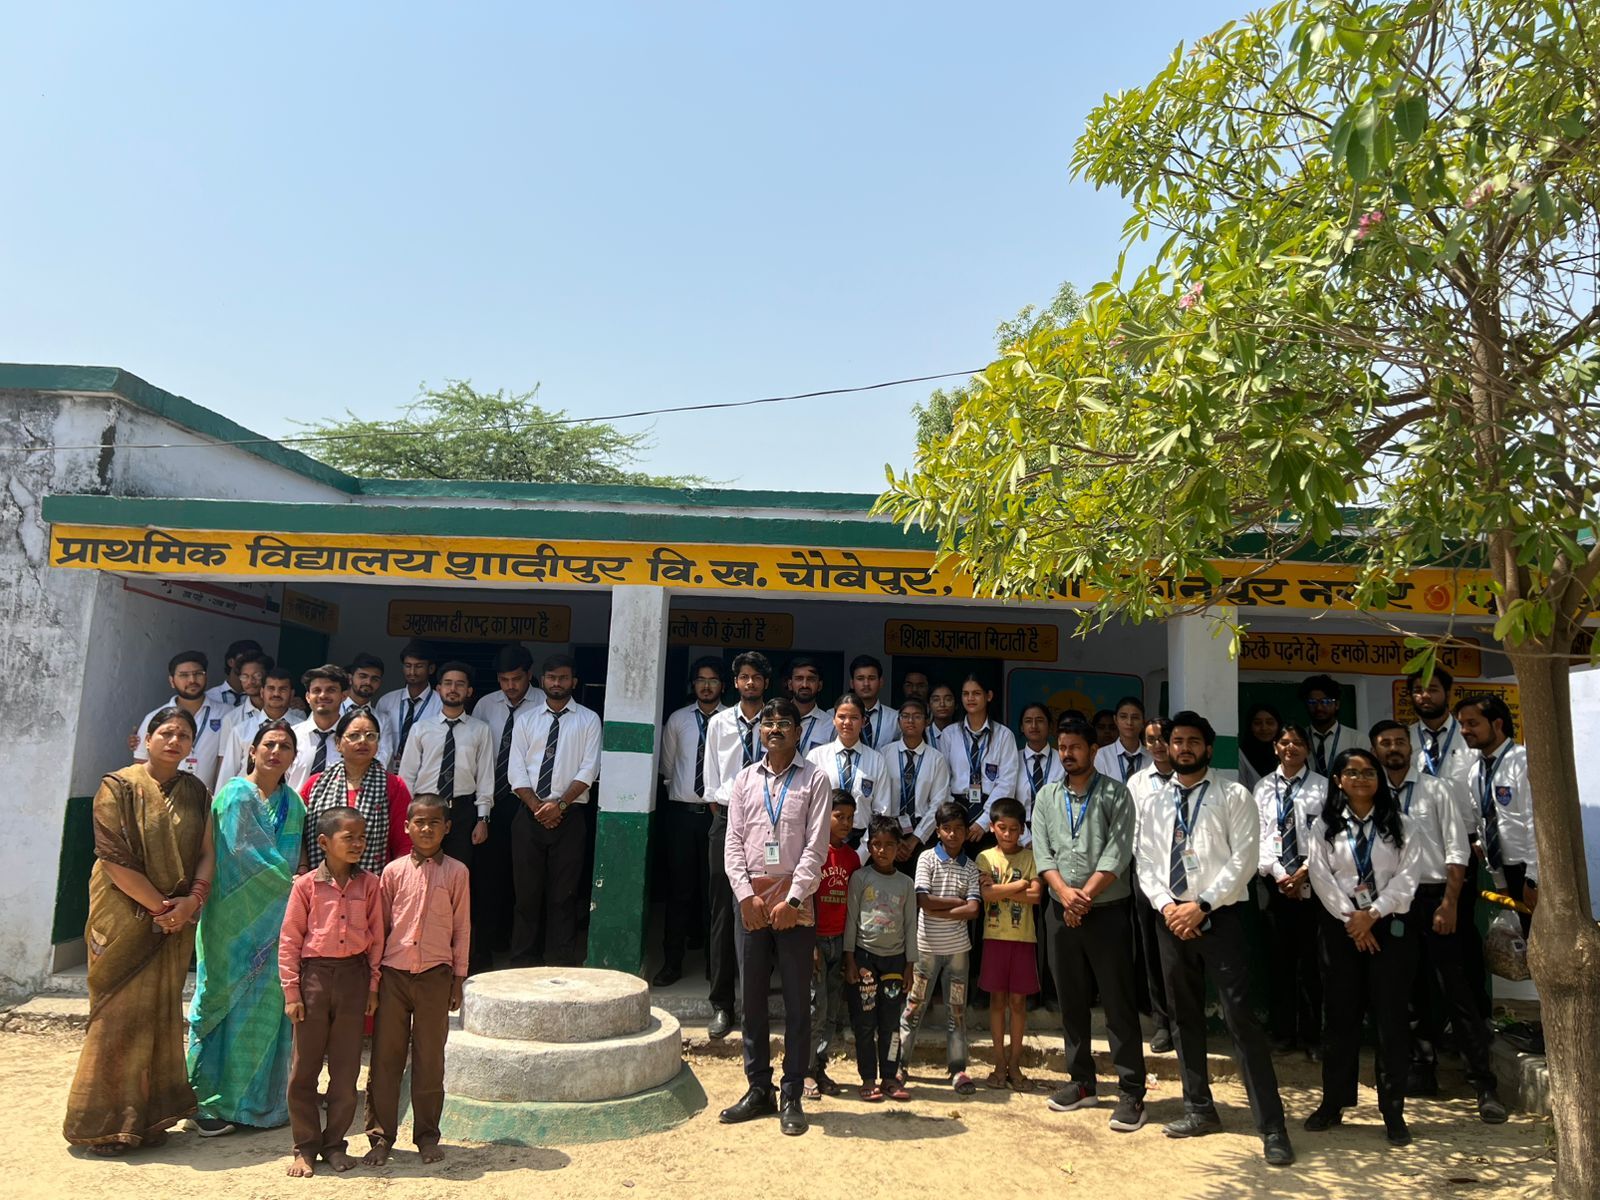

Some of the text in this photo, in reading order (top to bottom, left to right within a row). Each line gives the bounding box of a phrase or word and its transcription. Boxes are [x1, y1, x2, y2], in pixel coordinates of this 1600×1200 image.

[54, 529, 233, 567] प्राथमिक
[244, 535, 442, 575] विद्यालय
[444, 543, 633, 584] शादीपुर
[402, 609, 550, 638] अनुशासन ही राष्ट्र का प्राण है
[669, 615, 699, 639] न्तोष
[701, 615, 719, 639] की
[754, 617, 767, 642] है
[899, 623, 1040, 654] शिक्षा अज्ञानता मिटाती है
[1271, 636, 1306, 665] पढ़ने
[1306, 636, 1320, 665] दो
[1329, 639, 1370, 665] हमको
[1371, 639, 1402, 665] आगे
[819, 865, 850, 881] MERIC
